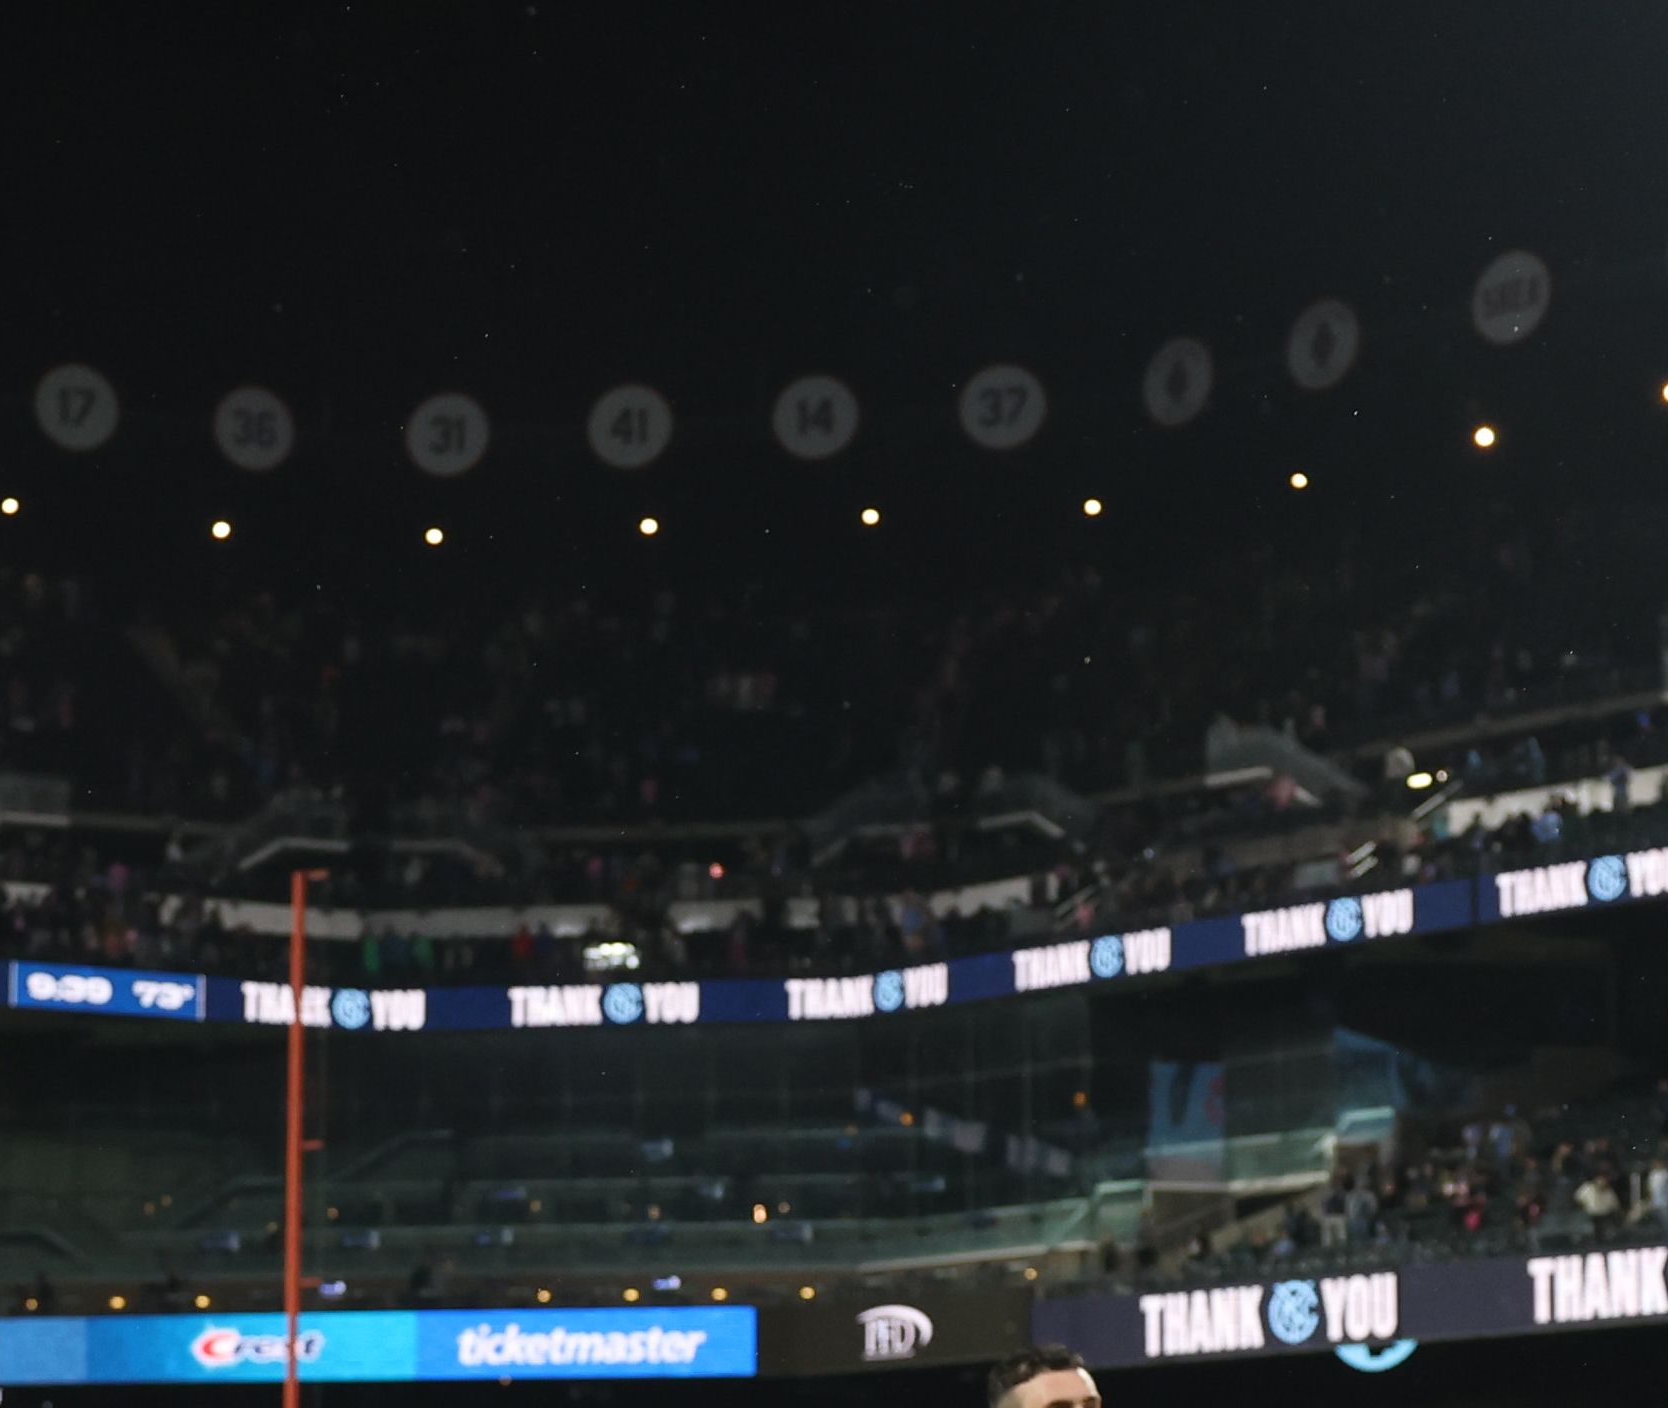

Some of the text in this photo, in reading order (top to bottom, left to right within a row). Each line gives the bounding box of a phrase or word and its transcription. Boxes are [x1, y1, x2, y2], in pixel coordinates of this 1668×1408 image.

[58, 386, 95, 427] 17
[796, 397, 835, 435] 14
[979, 384, 1029, 427] 37
[429, 416, 466, 456] 31
[610, 408, 648, 447] 41
[1494, 866, 1587, 918] THANK
[1241, 889, 1413, 956] THANK YOU
[1012, 928, 1170, 991] THANK YOU
[370, 990, 425, 1030] YOU
[508, 982, 699, 1026] THANK YOU
[785, 963, 947, 1019] THANK YOU
[1140, 1285, 1264, 1357] THANK
[1321, 1273, 1397, 1341] YOU
[457, 1323, 707, 1366] ticketmaster
